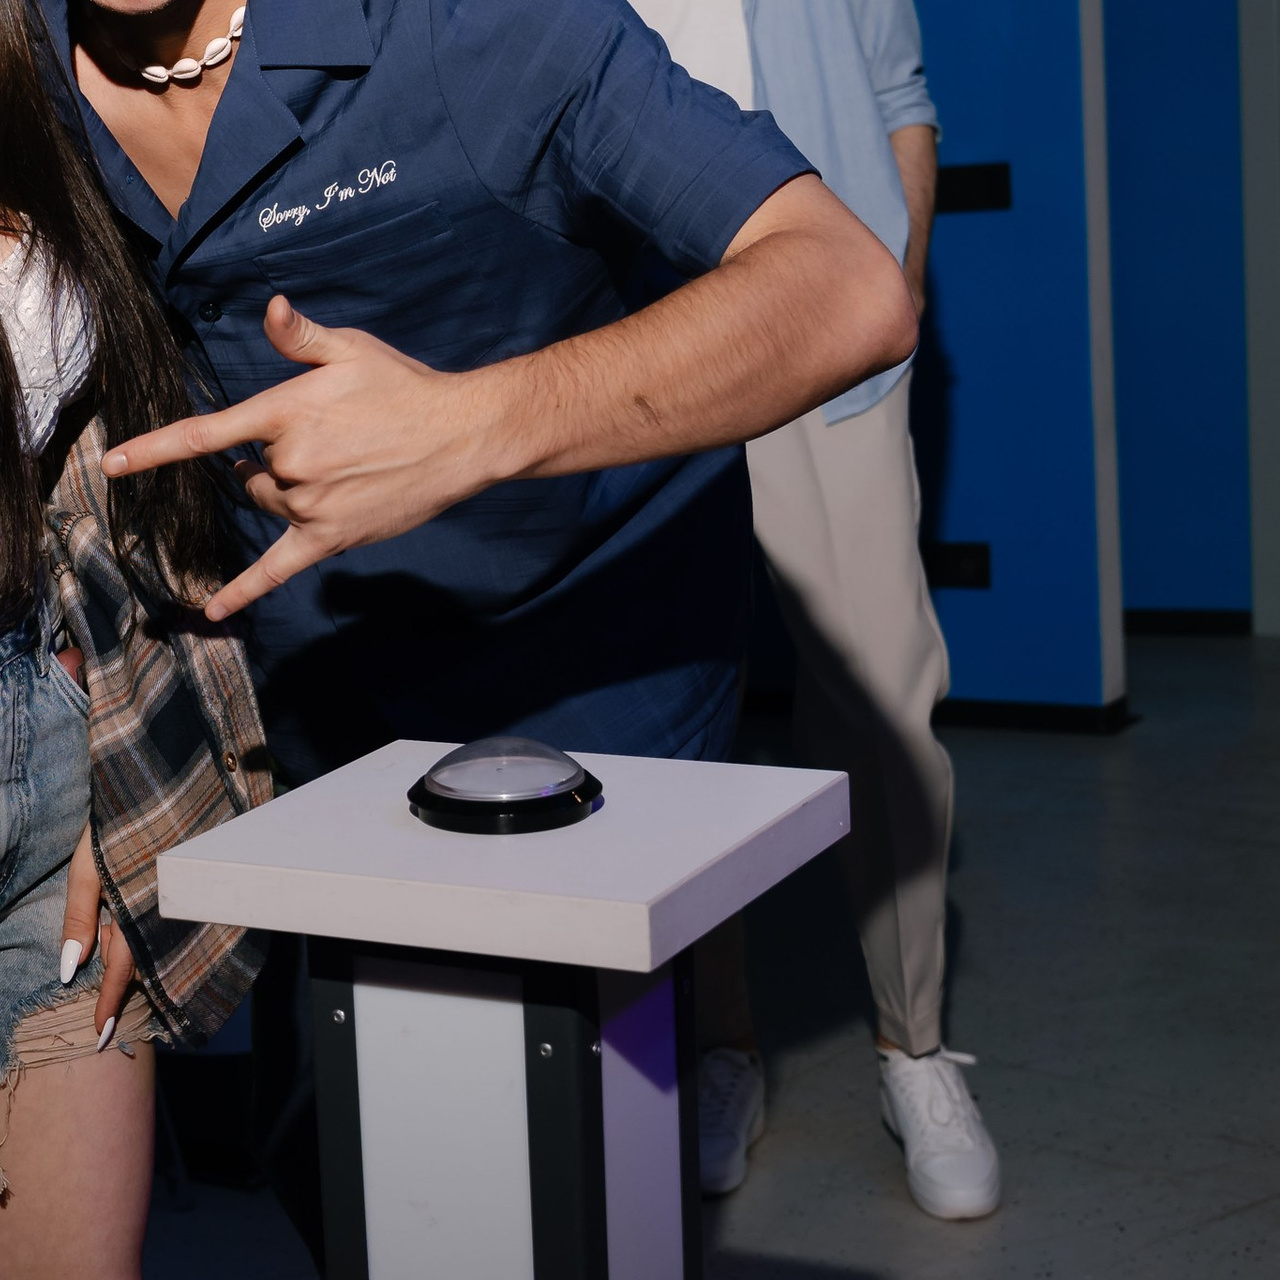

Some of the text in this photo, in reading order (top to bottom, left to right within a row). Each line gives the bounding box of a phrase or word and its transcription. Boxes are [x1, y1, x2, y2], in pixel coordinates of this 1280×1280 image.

[259, 160, 397, 232] Sorry, I'm Not
